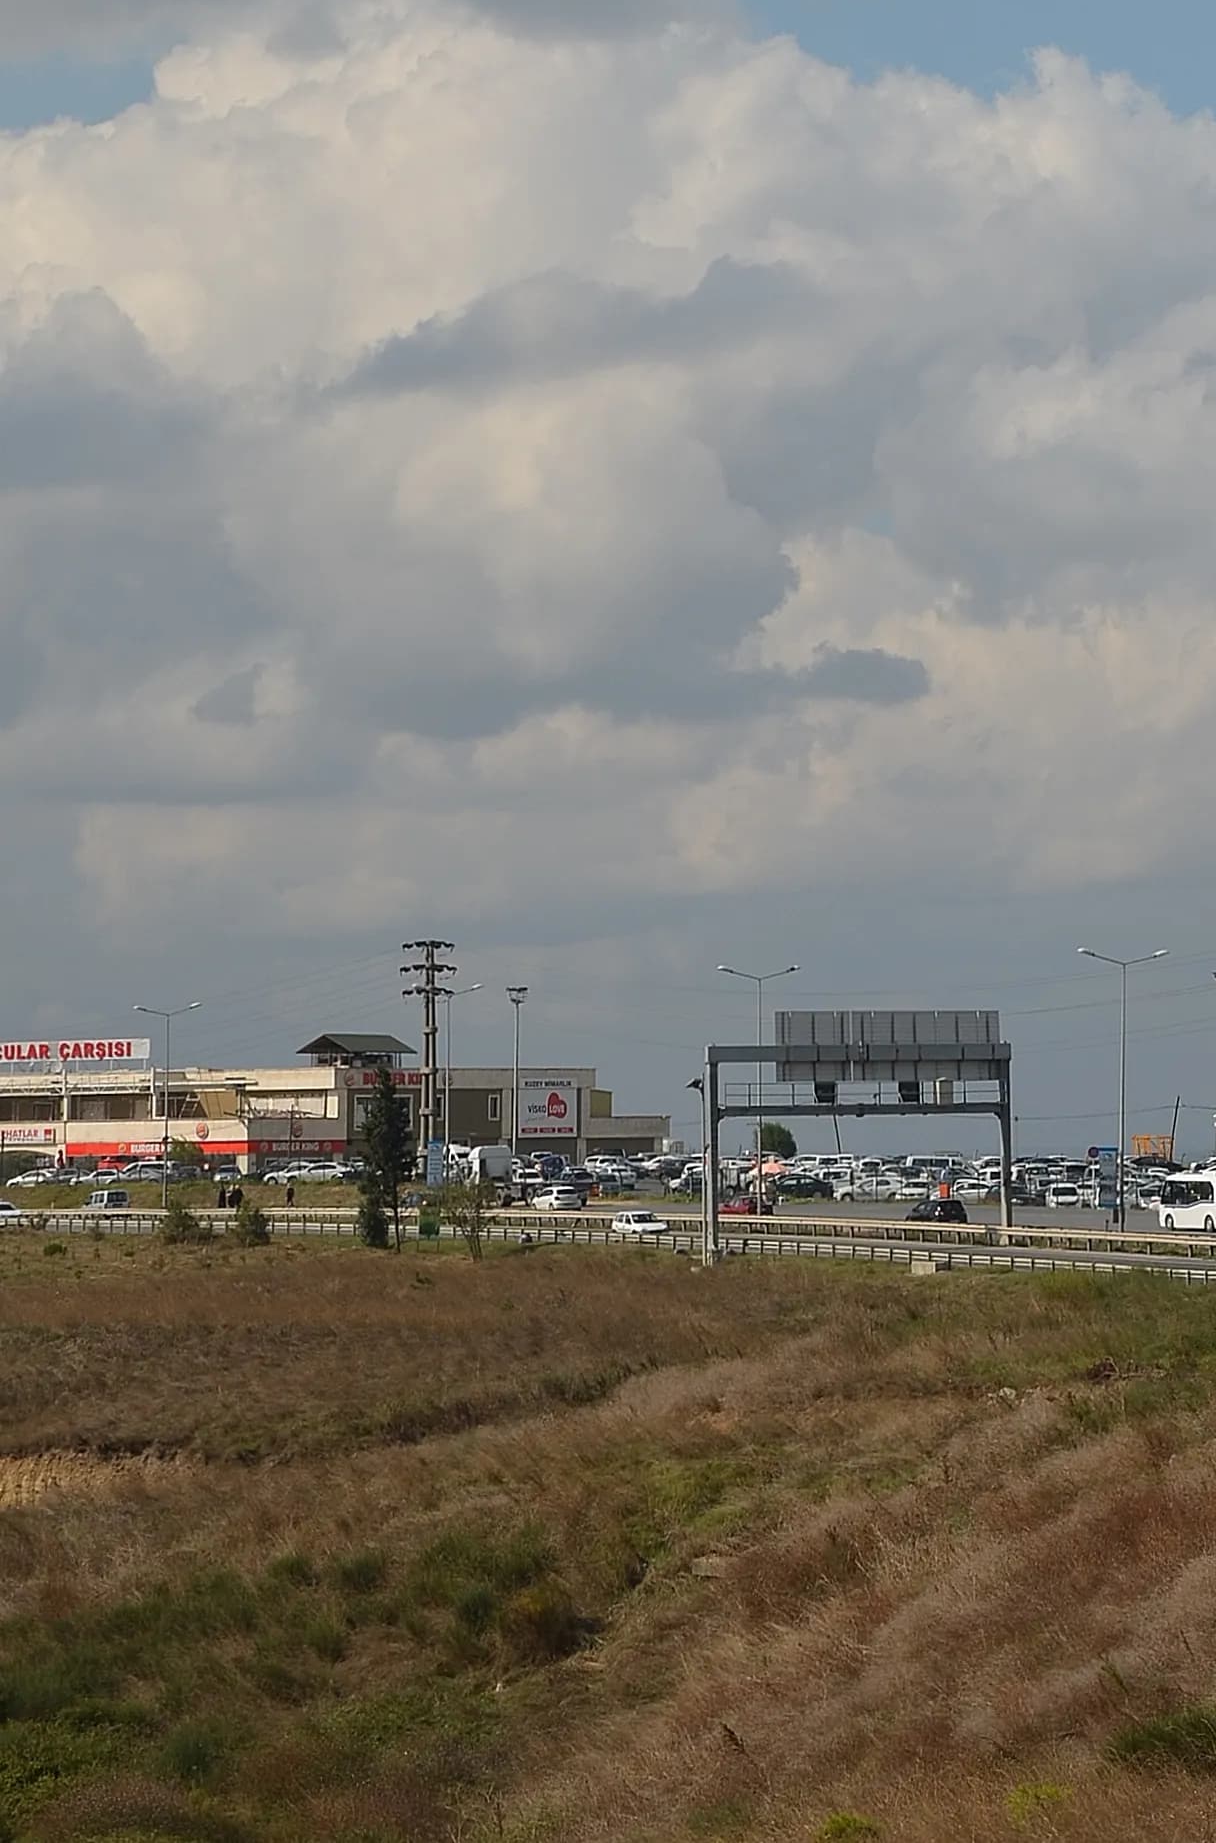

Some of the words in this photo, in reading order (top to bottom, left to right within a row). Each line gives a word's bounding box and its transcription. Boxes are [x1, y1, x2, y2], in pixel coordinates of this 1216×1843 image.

[0, 1044, 50, 1061] ULAR
[59, 1041, 132, 1061] ÇARŞISI
[549, 1104, 565, 1114] LOVE
